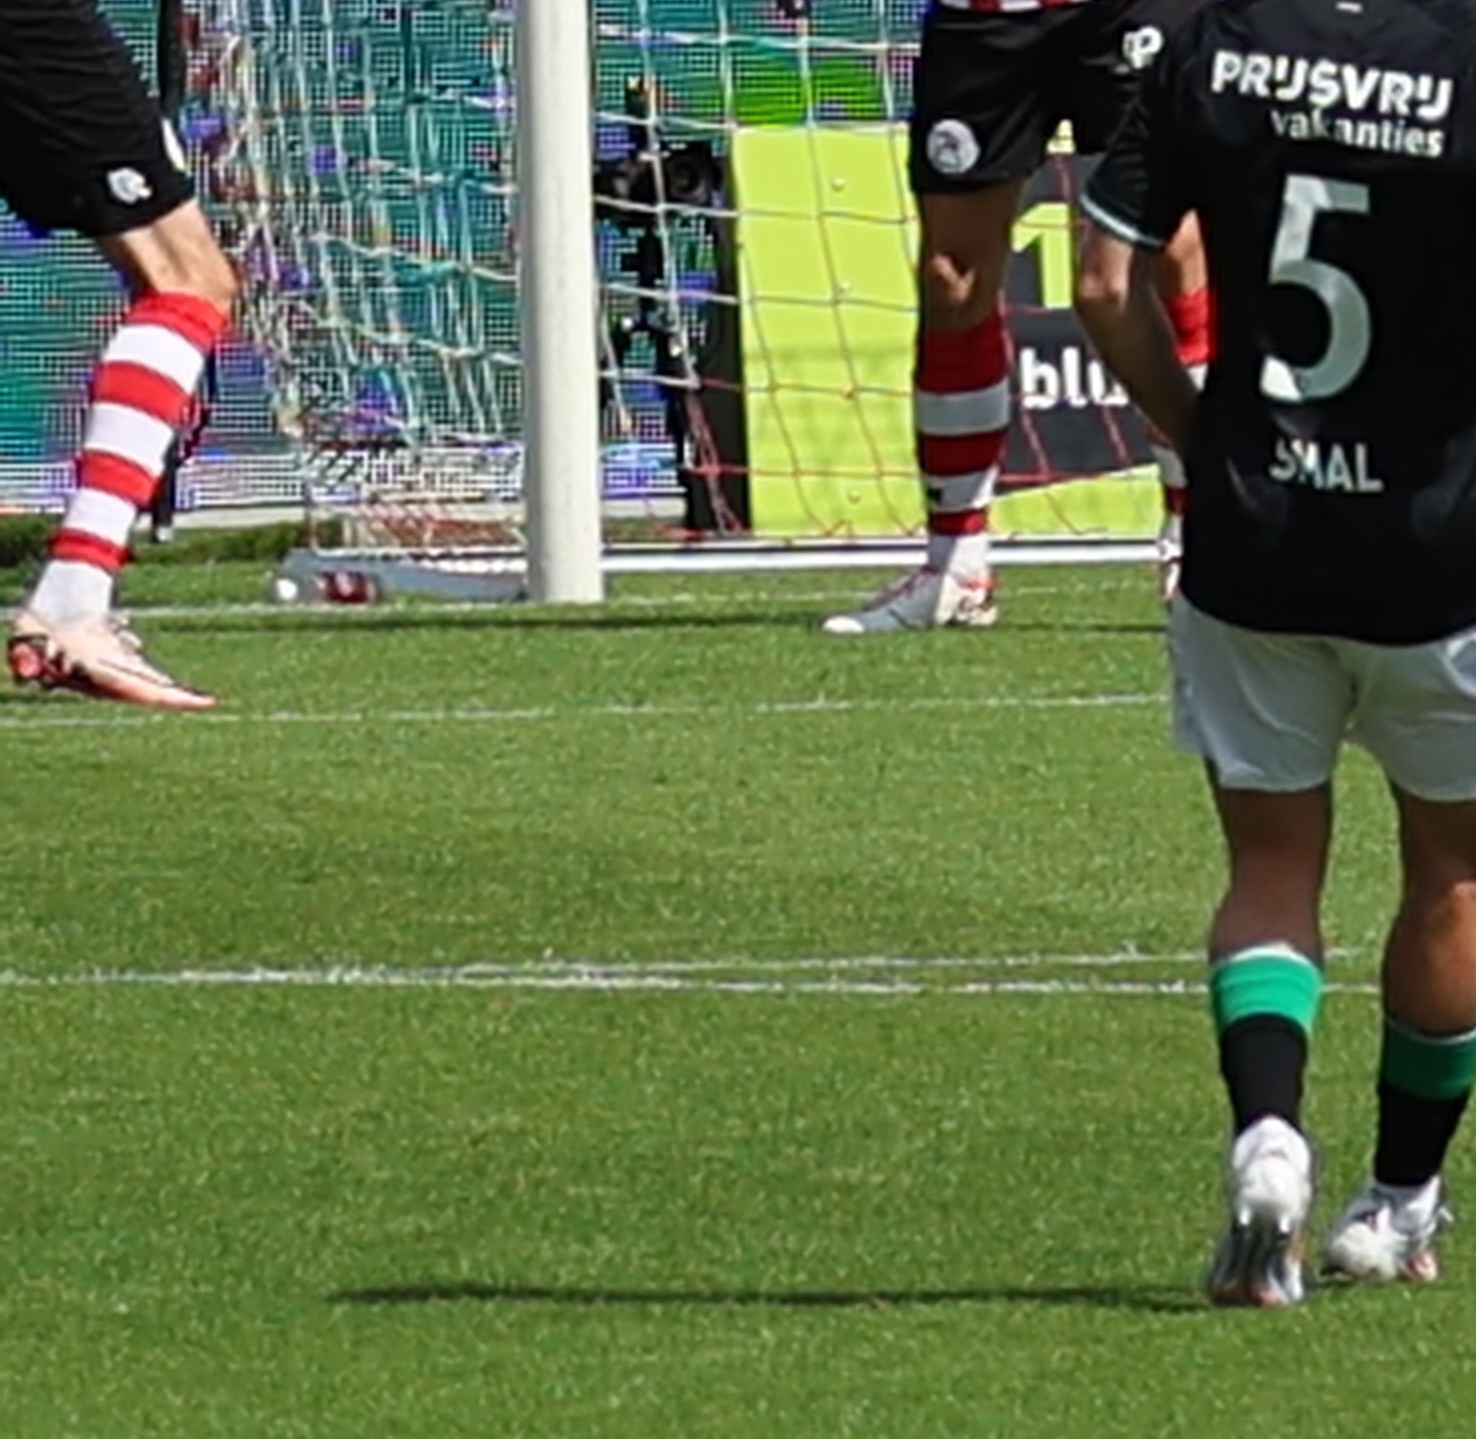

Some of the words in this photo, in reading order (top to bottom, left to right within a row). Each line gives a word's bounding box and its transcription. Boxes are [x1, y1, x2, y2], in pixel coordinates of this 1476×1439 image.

[1211, 50, 1453, 120] PRIJSVRIJ
[1271, 109, 1443, 157] vakanties
[1259, 173, 1371, 401] 5
[1270, 440, 1384, 491] SMAL
